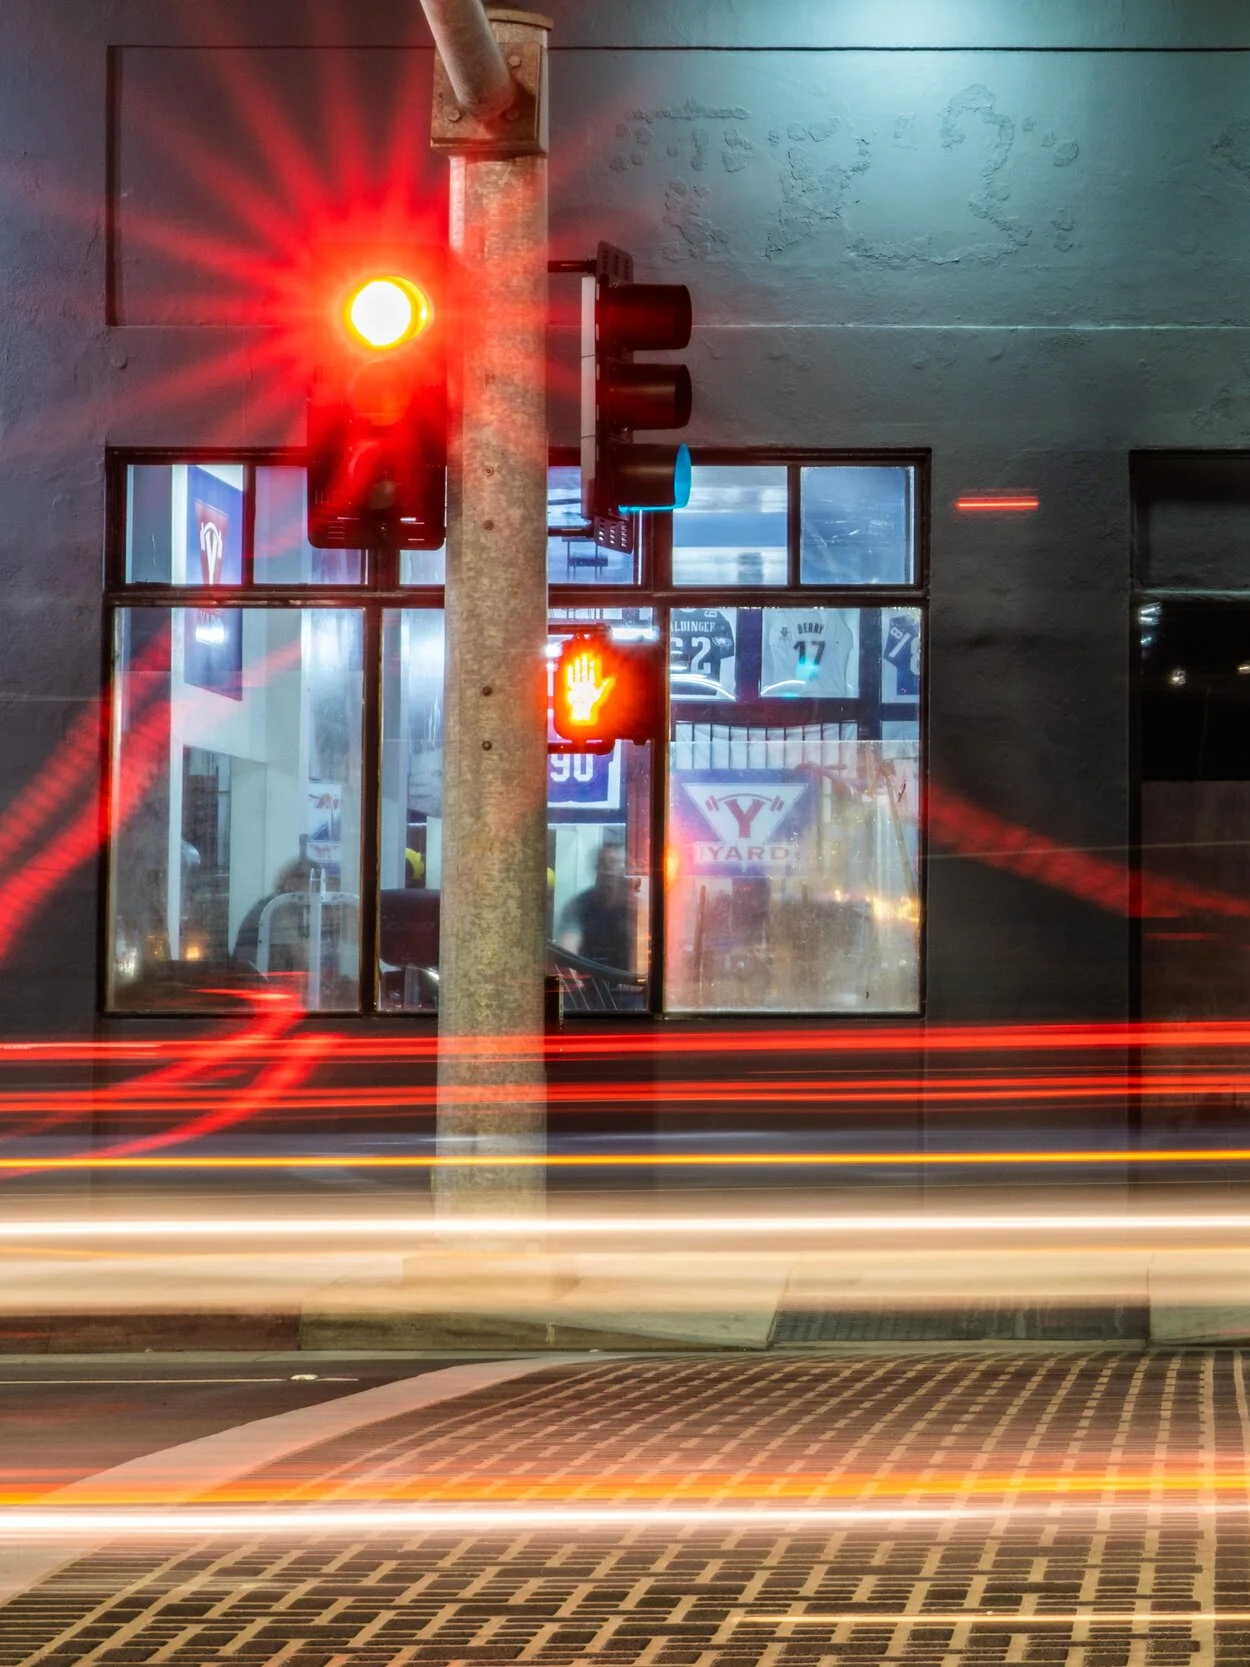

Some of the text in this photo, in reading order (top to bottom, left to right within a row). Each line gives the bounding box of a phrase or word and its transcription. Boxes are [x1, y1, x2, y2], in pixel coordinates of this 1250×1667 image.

[671, 621, 716, 633] LDINGER
[793, 640, 826, 665] 17
[707, 846, 790, 861] YARD
